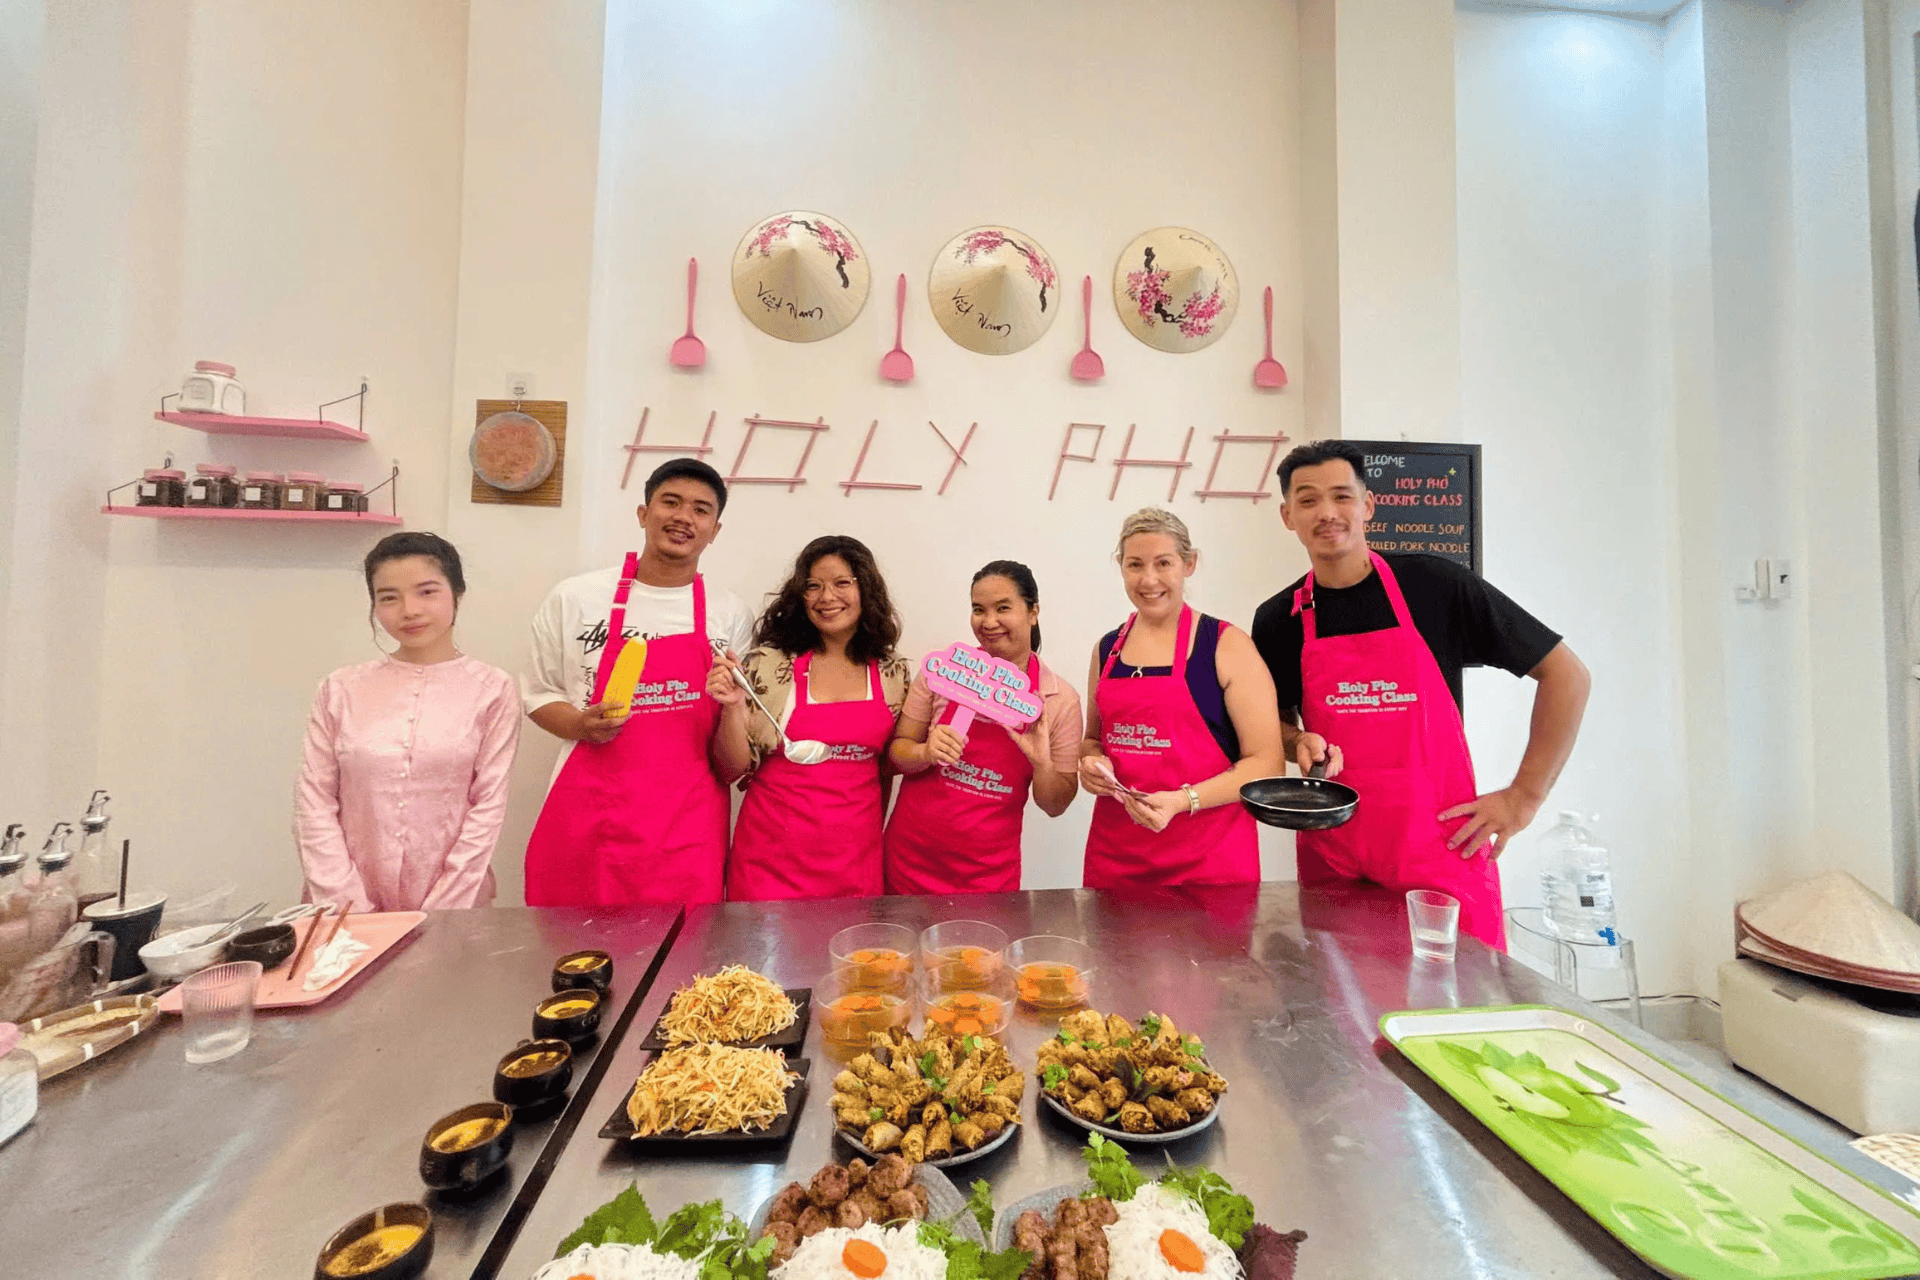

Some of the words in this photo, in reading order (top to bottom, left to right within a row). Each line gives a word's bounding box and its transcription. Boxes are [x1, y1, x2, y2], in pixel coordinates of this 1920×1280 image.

[620, 406, 978, 498] HOLY
[1049, 423, 1291, 505] PHO
[1364, 454, 1406, 468] ELCOME
[1367, 467, 1383, 478] TO
[1395, 477, 1423, 490] HOLY
[1374, 493, 1421, 506] COOKING
[1423, 493, 1463, 507] CLASS
[1395, 523, 1435, 533] NOODLE
[1438, 523, 1465, 535] SOUP
[1399, 541, 1425, 552] PORK
[1429, 542, 1471, 553] NOODLE
[949, 647, 991, 677] Holy
[989, 665, 1025, 690] Pho
[633, 682, 664, 694] Holy
[665, 680, 690, 692] Pho
[926, 656, 994, 700] Cooking
[993, 687, 1038, 717] Class
[1337, 681, 1369, 694] Holy
[1370, 679, 1399, 692] Pho
[630, 694, 673, 707] ooking
[1325, 693, 1381, 706] Cooking
[1381, 691, 1418, 703] Class
[1136, 723, 1157, 735] Pho
[953, 760, 981, 777] Holy
[981, 767, 1003, 781] Pho
[940, 766, 985, 790] Cooking
[985, 780, 1013, 794] Class
